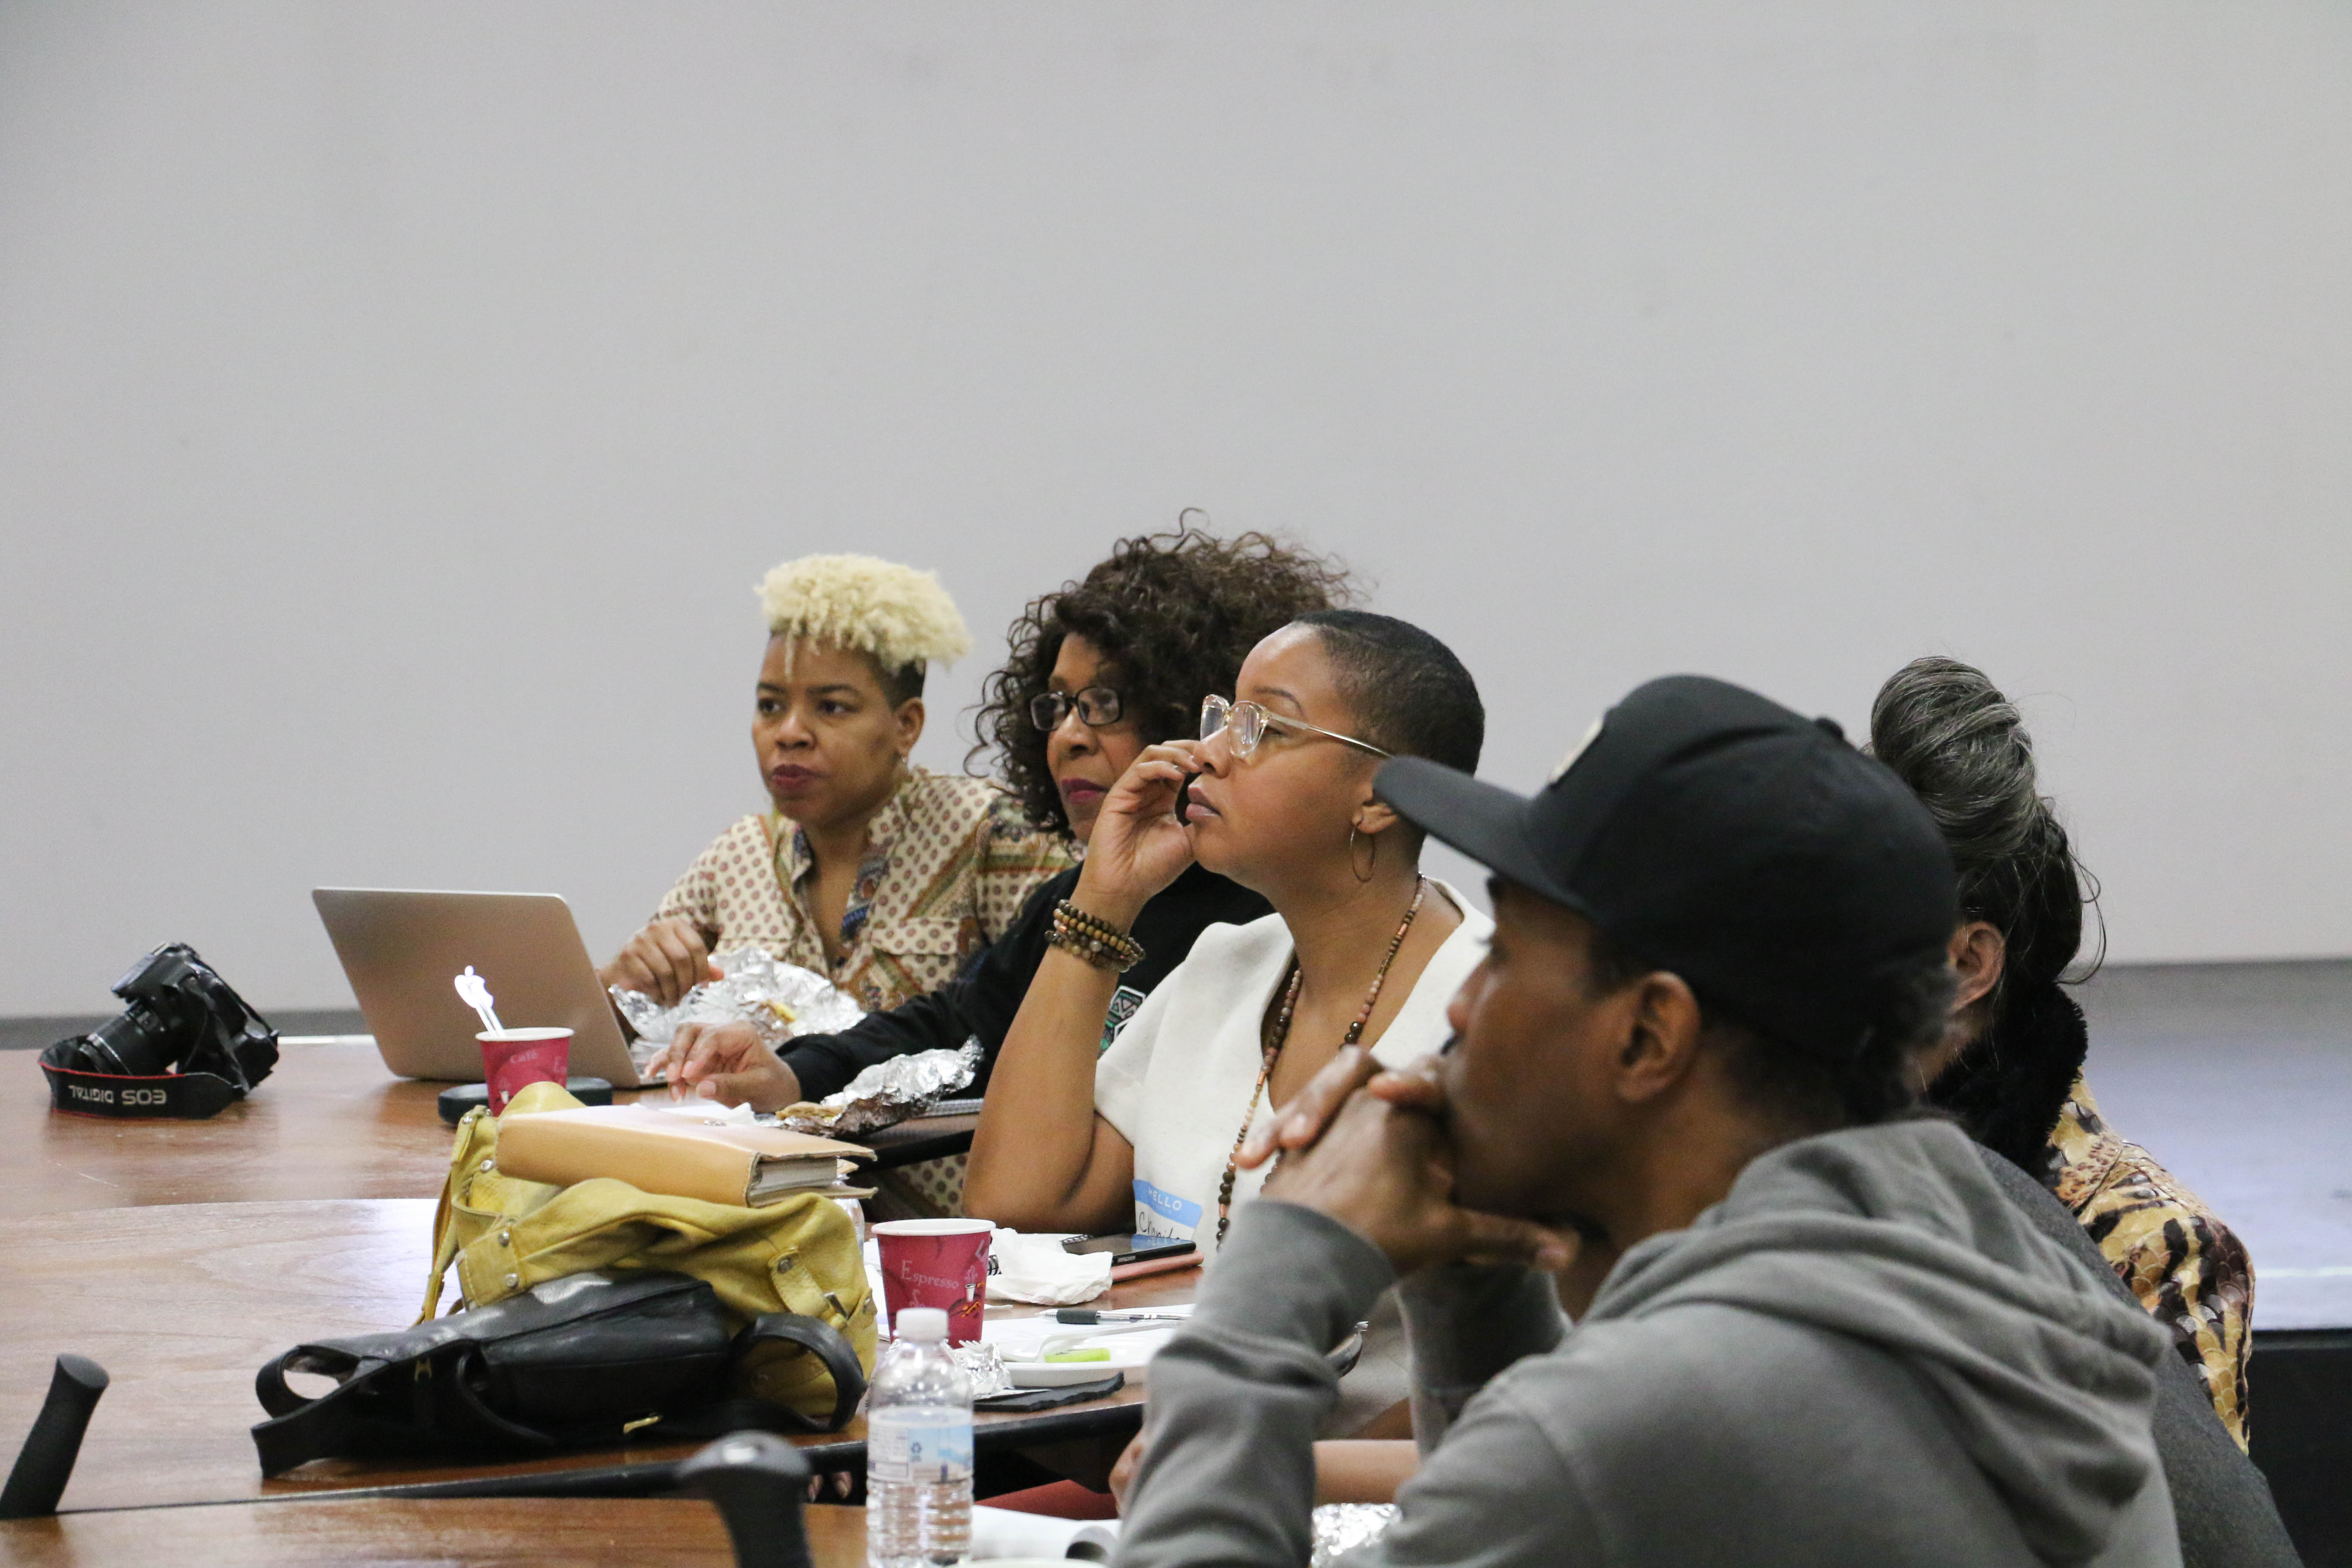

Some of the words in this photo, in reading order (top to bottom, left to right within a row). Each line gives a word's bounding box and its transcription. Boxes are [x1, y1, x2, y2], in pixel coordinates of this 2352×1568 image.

[68, 1085, 114, 1103] DIGITAL
[122, 1089, 167, 1106] EOS
[901, 1260, 959, 1289] Espresso
